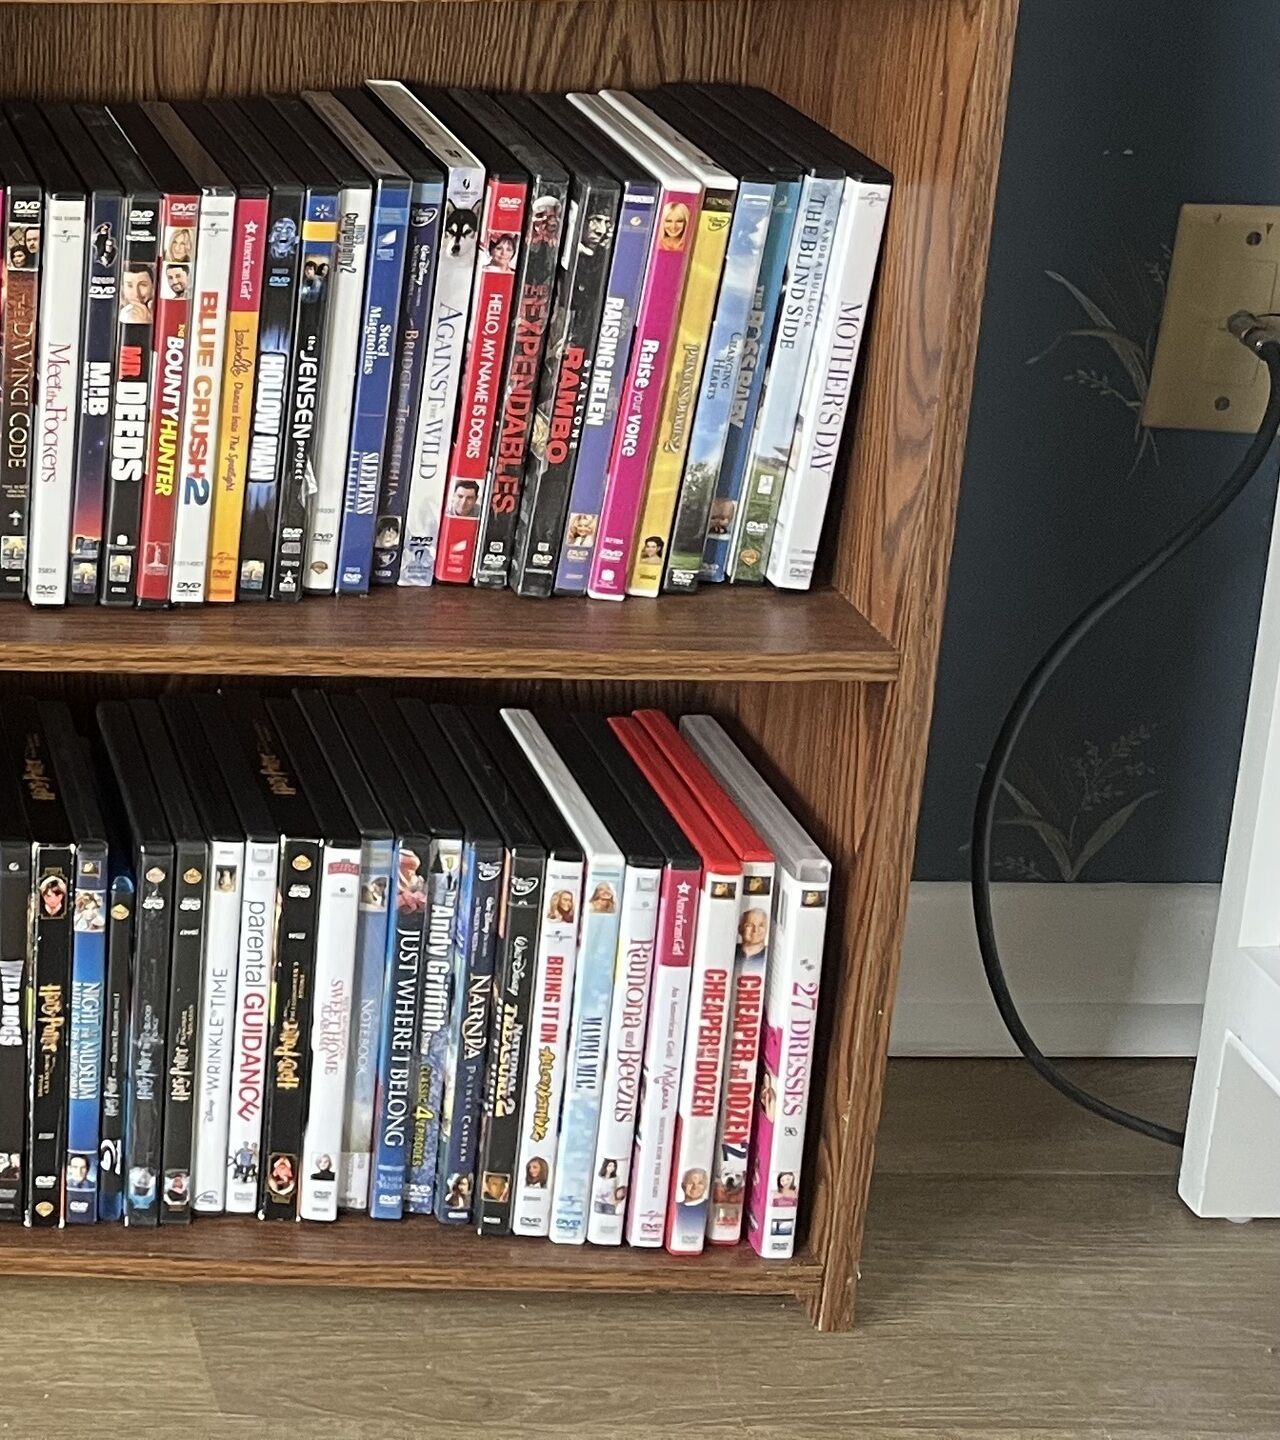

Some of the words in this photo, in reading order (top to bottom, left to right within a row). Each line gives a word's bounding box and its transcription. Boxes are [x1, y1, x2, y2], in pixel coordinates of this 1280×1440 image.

[196, 291, 219, 367] BLUE
[426, 302, 464, 416] AGAINST
[820, 301, 863, 426] MOTHER'S
[111, 381, 147, 481] DEEDS
[185, 375, 214, 478] CRUSH
[547, 347, 585, 465] RAMBO
[418, 418, 447, 479] WILD
[809, 431, 838, 475] DAY
[243, 900, 268, 988] parental
[397, 928, 421, 976] JUST
[391, 978, 418, 1052] WHERE
[697, 969, 727, 1048] CHEAPER
[792, 981, 818, 1010] 27
[237, 992, 265, 1121] GUIDANCE
[691, 1060, 718, 1117] DOZEN
[783, 1020, 812, 1116] DRESSES
[384, 1069, 410, 1146] BELONG
